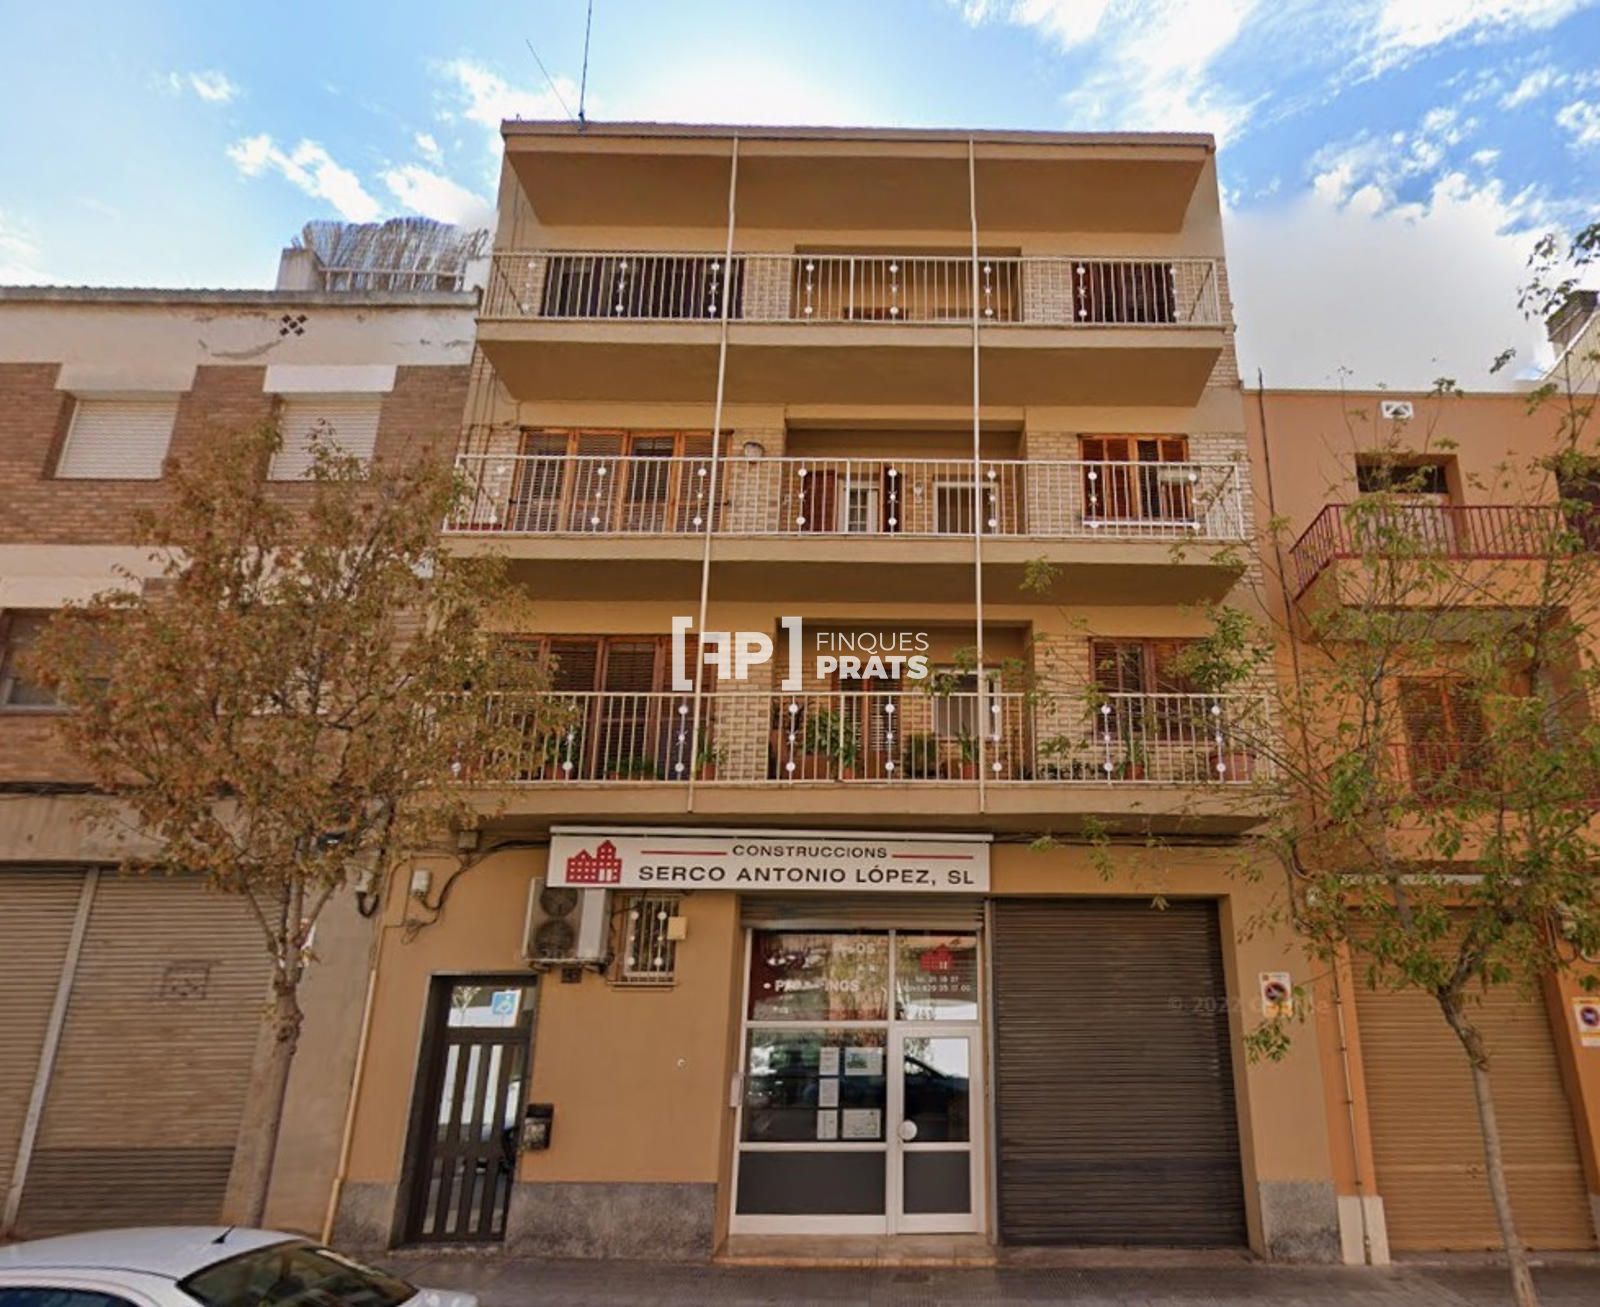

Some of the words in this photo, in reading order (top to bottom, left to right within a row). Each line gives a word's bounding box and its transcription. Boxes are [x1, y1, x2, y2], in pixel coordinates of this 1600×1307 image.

[732, 844, 888, 859] CONSTRUCCIONS
[638, 865, 726, 881] SERCO
[736, 867, 847, 883] ANTONIO
[856, 865, 936, 886] LÓPEZ,
[947, 869, 975, 885] SL
